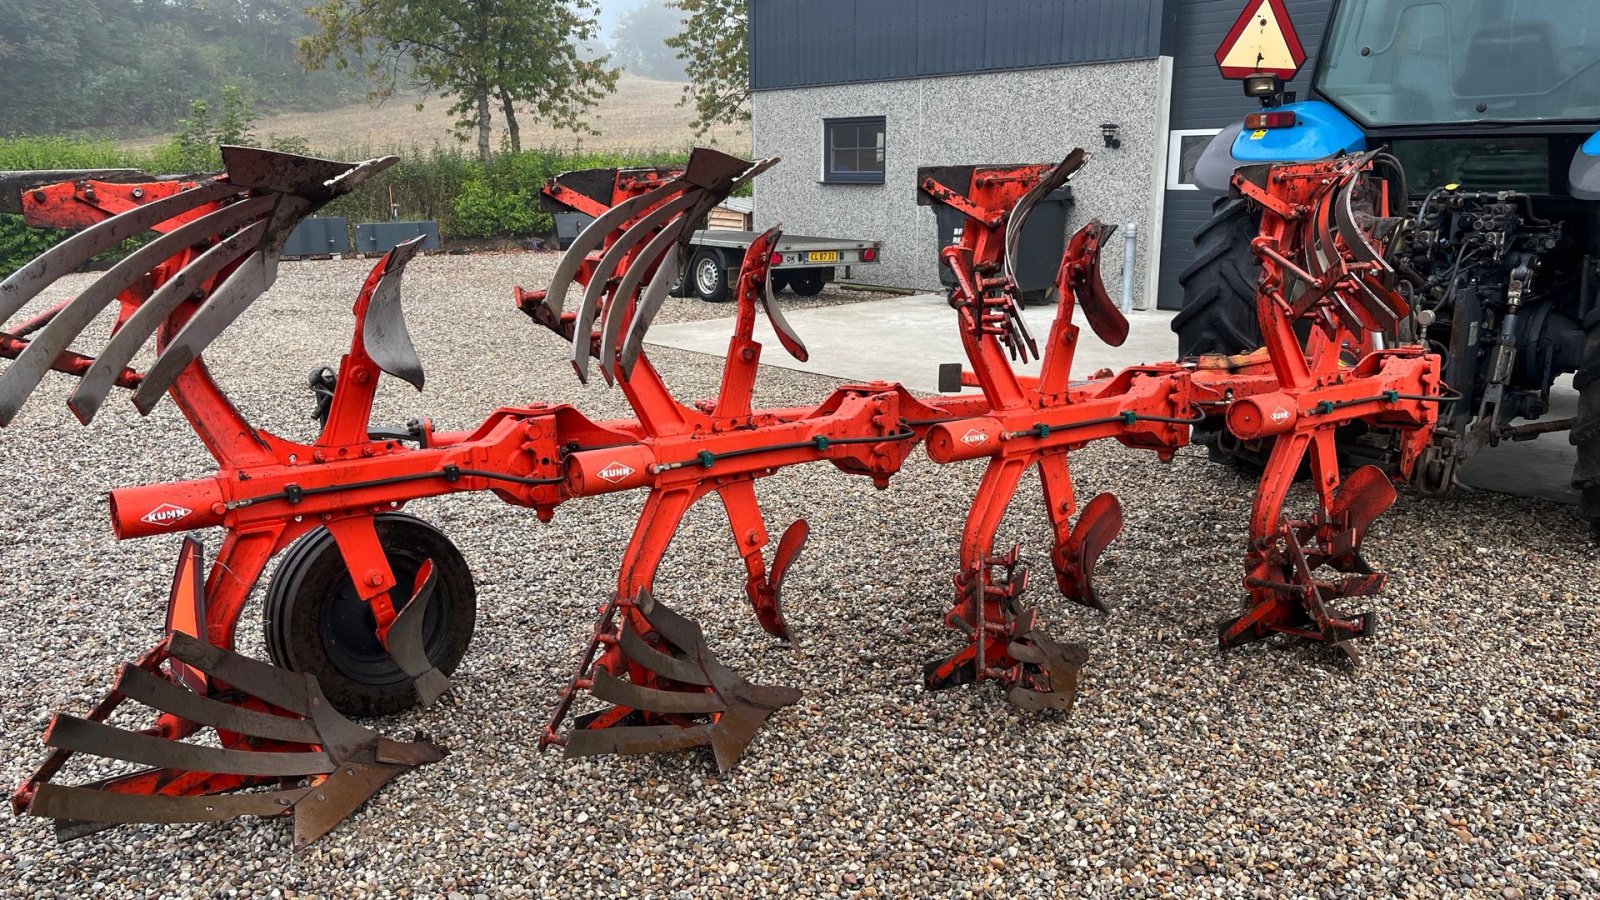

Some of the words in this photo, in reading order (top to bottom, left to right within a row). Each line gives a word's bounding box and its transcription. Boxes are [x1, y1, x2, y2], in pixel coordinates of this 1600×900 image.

[811, 252, 818, 260] CL
[819, 252, 827, 260] 87
[828, 252, 834, 260] 31
[964, 433, 985, 442] KUHN
[602, 467, 630, 478] KUHN
[148, 508, 186, 522] KUHN
